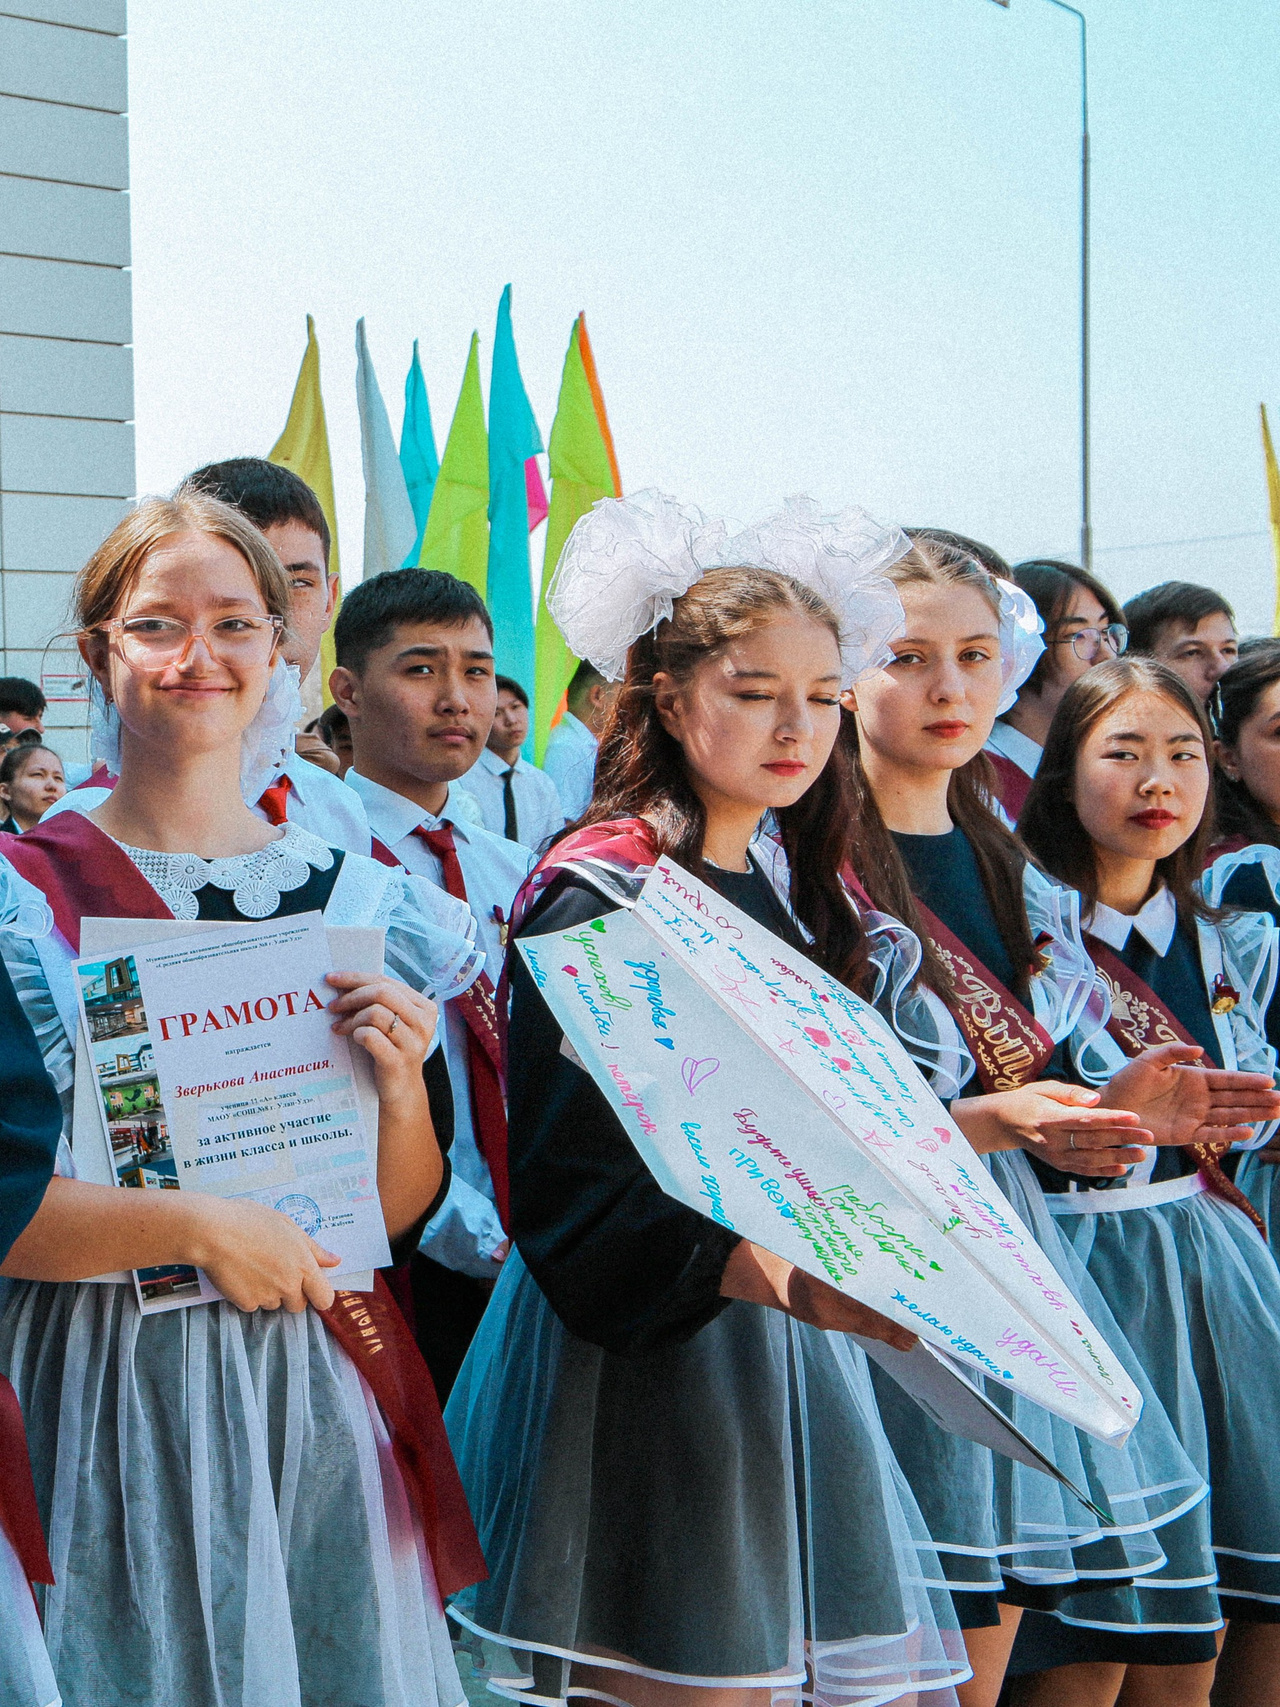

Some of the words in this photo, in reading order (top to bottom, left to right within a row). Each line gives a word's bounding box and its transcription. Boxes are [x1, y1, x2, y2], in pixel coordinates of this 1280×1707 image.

[157, 988, 327, 1042] ГРАМОТА
[225, 1041, 272, 1056] награждается
[174, 1075, 245, 1099] Зверькова
[249, 1058, 335, 1085] Анастасия,
[207, 1112, 231, 1124] МАОУ
[220, 1101, 249, 1112] ученица
[273, 1090, 297, 1101] класса
[183, 1159, 192, 1169] в
[194, 1149, 237, 1167] жизни
[240, 1139, 286, 1158] класса
[288, 1138, 297, 1149] и
[301, 1127, 353, 1146] школы.
[197, 1136, 211, 1148] за
[214, 1121, 277, 1144] активное
[279, 1111, 332, 1134] участие
[733, 1108, 793, 1168] Будьте
[890, 1288, 953, 1336] желаю
[951, 1335, 1001, 1375] удачи
